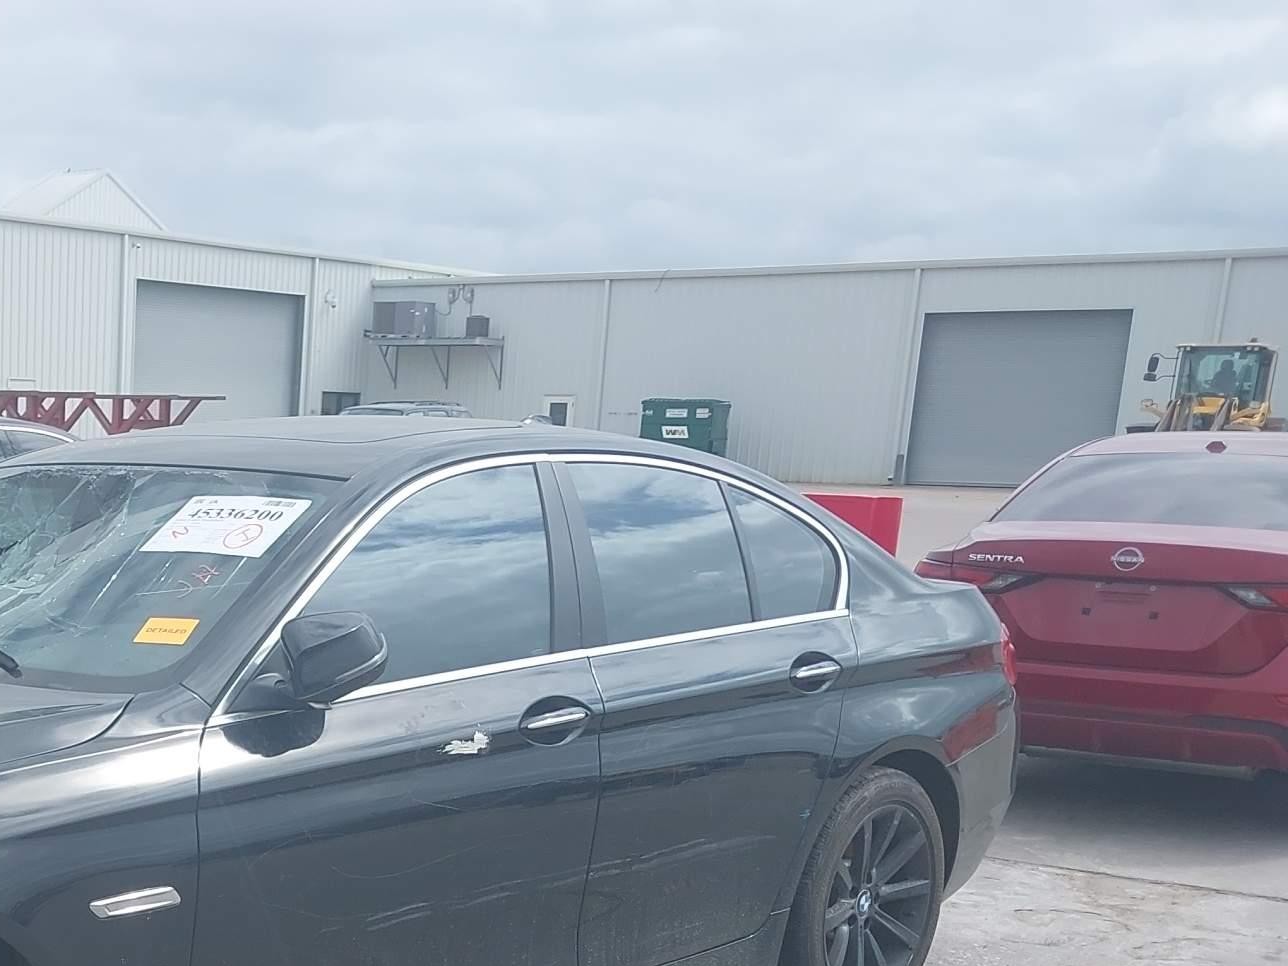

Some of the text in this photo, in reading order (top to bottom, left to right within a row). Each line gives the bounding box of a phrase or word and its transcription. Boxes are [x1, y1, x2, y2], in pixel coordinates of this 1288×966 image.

[187, 508, 285, 521] 45336200
[968, 553, 1025, 564] SENTRA
[1111, 554, 1145, 564] NISSAN
